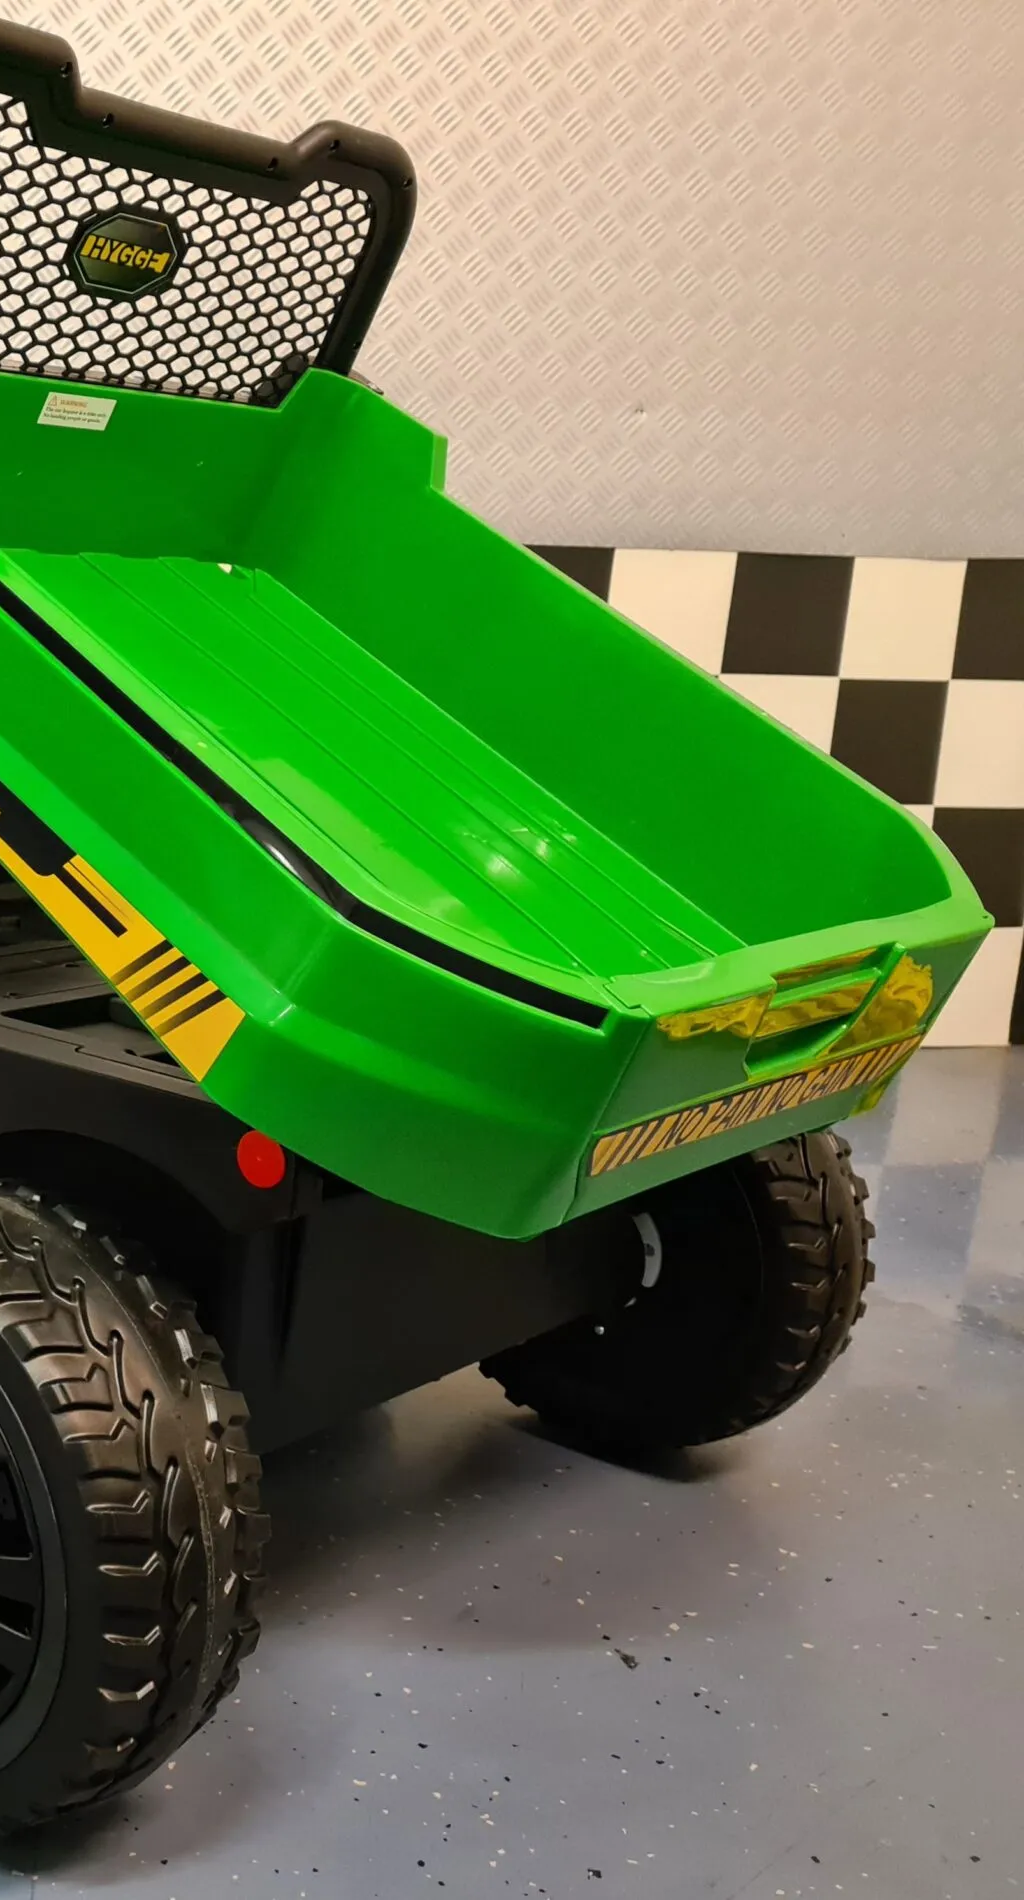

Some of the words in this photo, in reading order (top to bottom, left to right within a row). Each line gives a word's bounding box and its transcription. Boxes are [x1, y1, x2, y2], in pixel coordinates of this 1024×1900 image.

[82, 234, 167, 272] HYGGE
[652, 1104, 709, 1150] NO
[696, 1084, 773, 1138] PAIN
[756, 1072, 808, 1118] NO
[797, 1055, 863, 1104] GAIN
